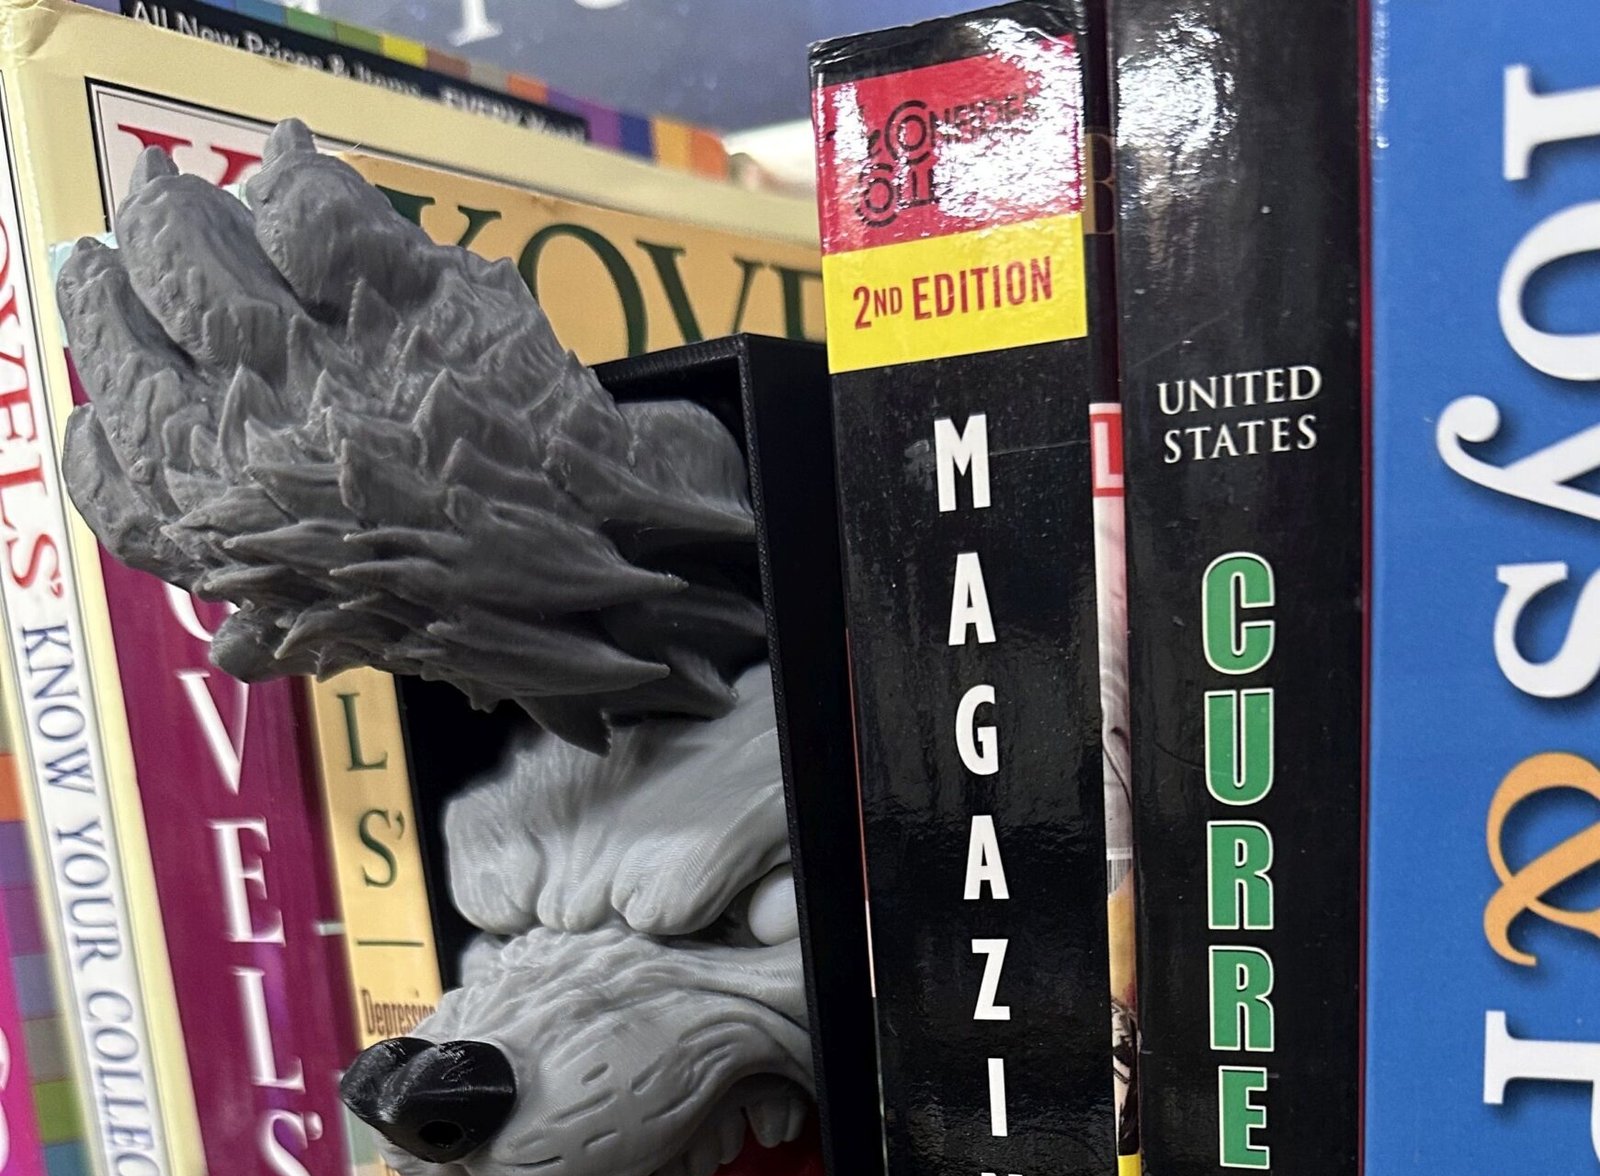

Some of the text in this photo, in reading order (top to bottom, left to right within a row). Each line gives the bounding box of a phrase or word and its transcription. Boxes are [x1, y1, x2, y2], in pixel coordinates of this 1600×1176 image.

[132, 1, 168, 31] All
[853, 256, 1053, 330] 2ND EDITION
[0, 215, 64, 599] ELS'
[1157, 365, 1322, 415] UNITED
[1164, 414, 1318, 464] STATES
[20, 621, 96, 796] KNOW
[56, 821, 118, 970] YOUR
[361, 988, 436, 1038] Depressi
